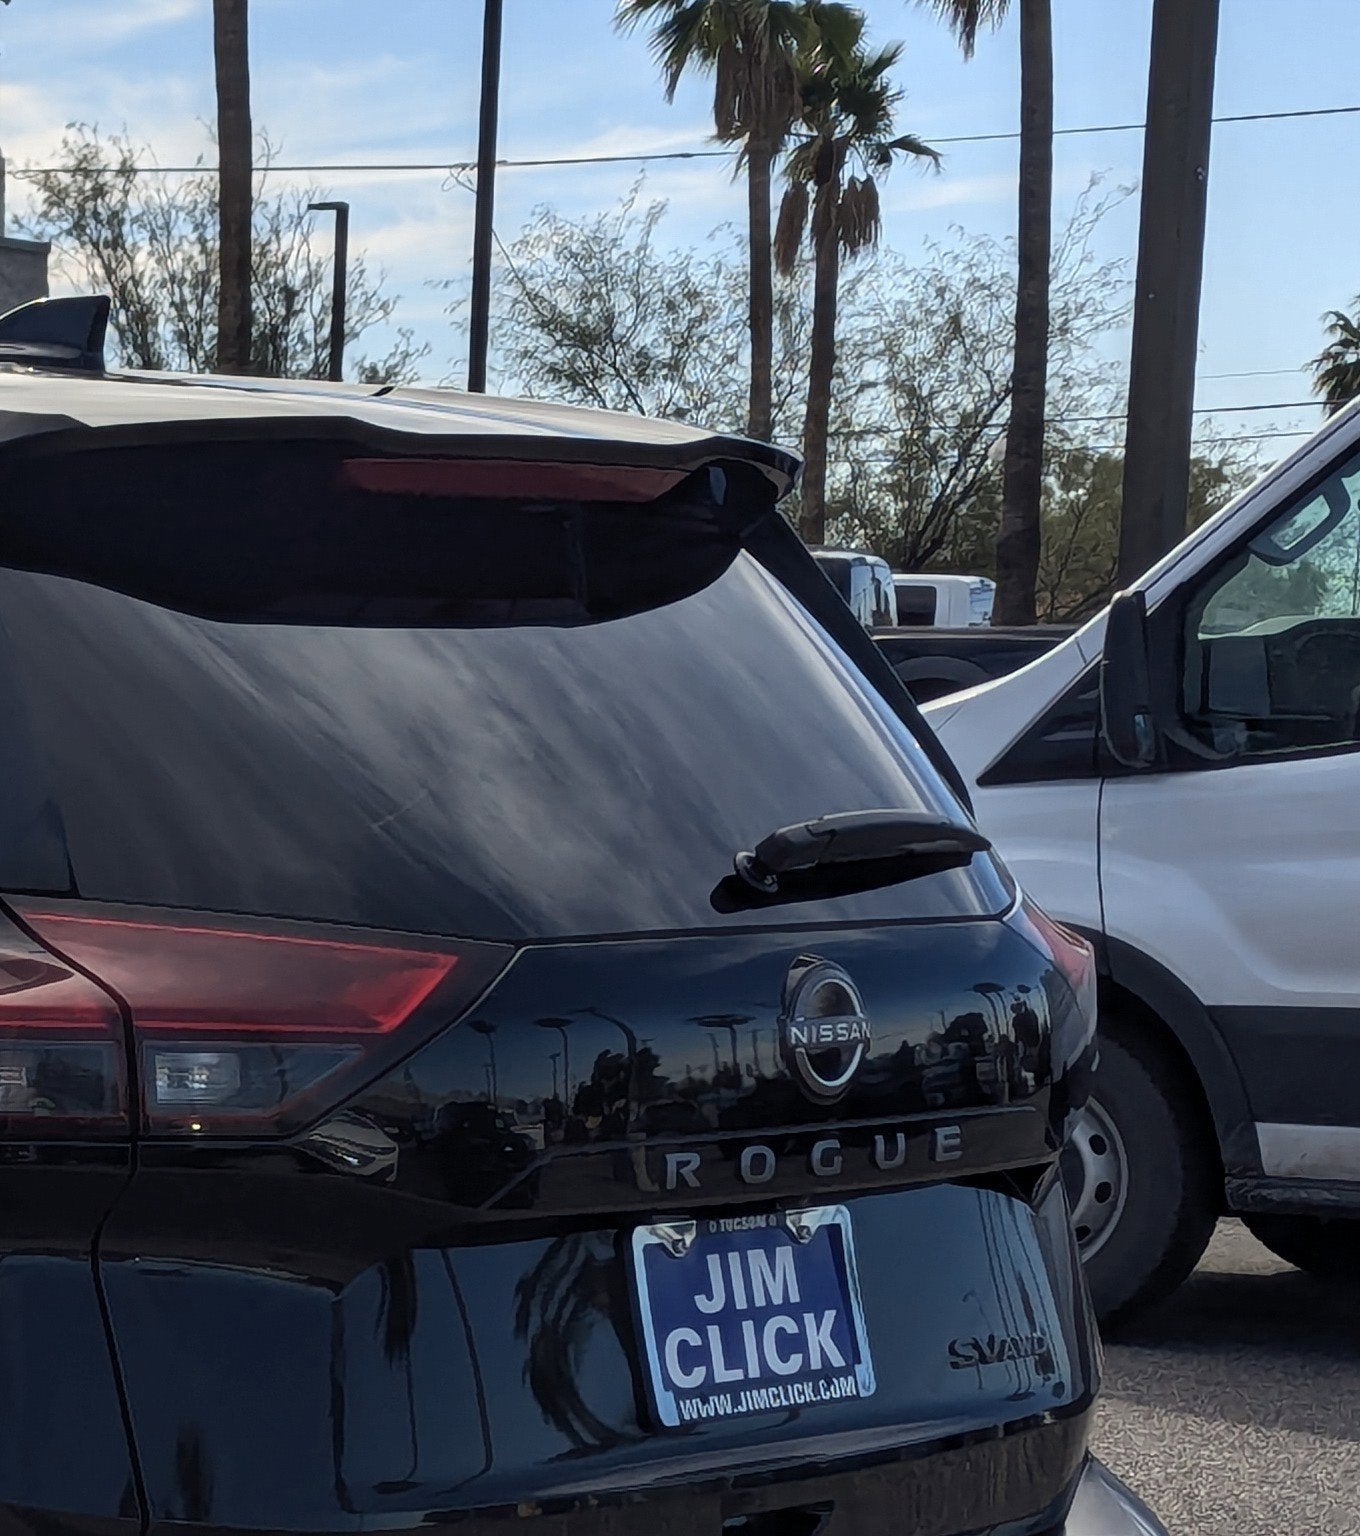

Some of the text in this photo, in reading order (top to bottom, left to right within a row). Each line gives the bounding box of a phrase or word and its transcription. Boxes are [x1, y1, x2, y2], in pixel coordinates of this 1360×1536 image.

[790, 1021, 871, 1045] NISSAN
[664, 1125, 962, 1190] ROGUE
[693, 1246, 801, 1314] JIM
[664, 1309, 846, 1388] CLICK
[679, 1375, 858, 1421] WWW.JIMCLICK.COM
